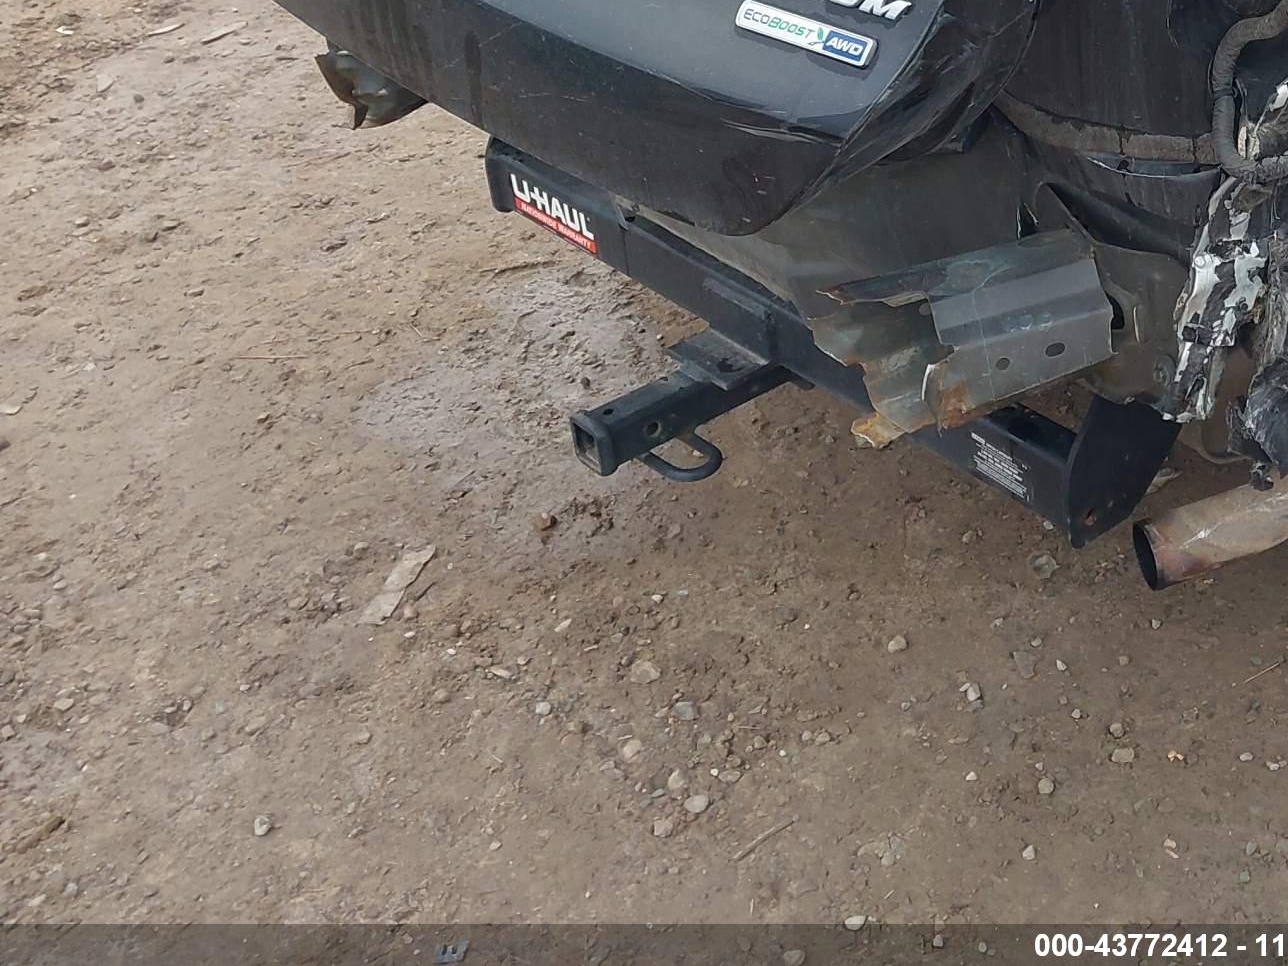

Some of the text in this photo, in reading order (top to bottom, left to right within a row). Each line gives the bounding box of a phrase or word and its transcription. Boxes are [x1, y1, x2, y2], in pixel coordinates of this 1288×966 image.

[743, 8, 864, 56] ECOBOOST AWD
[510, 173, 595, 240] U-HAUL
